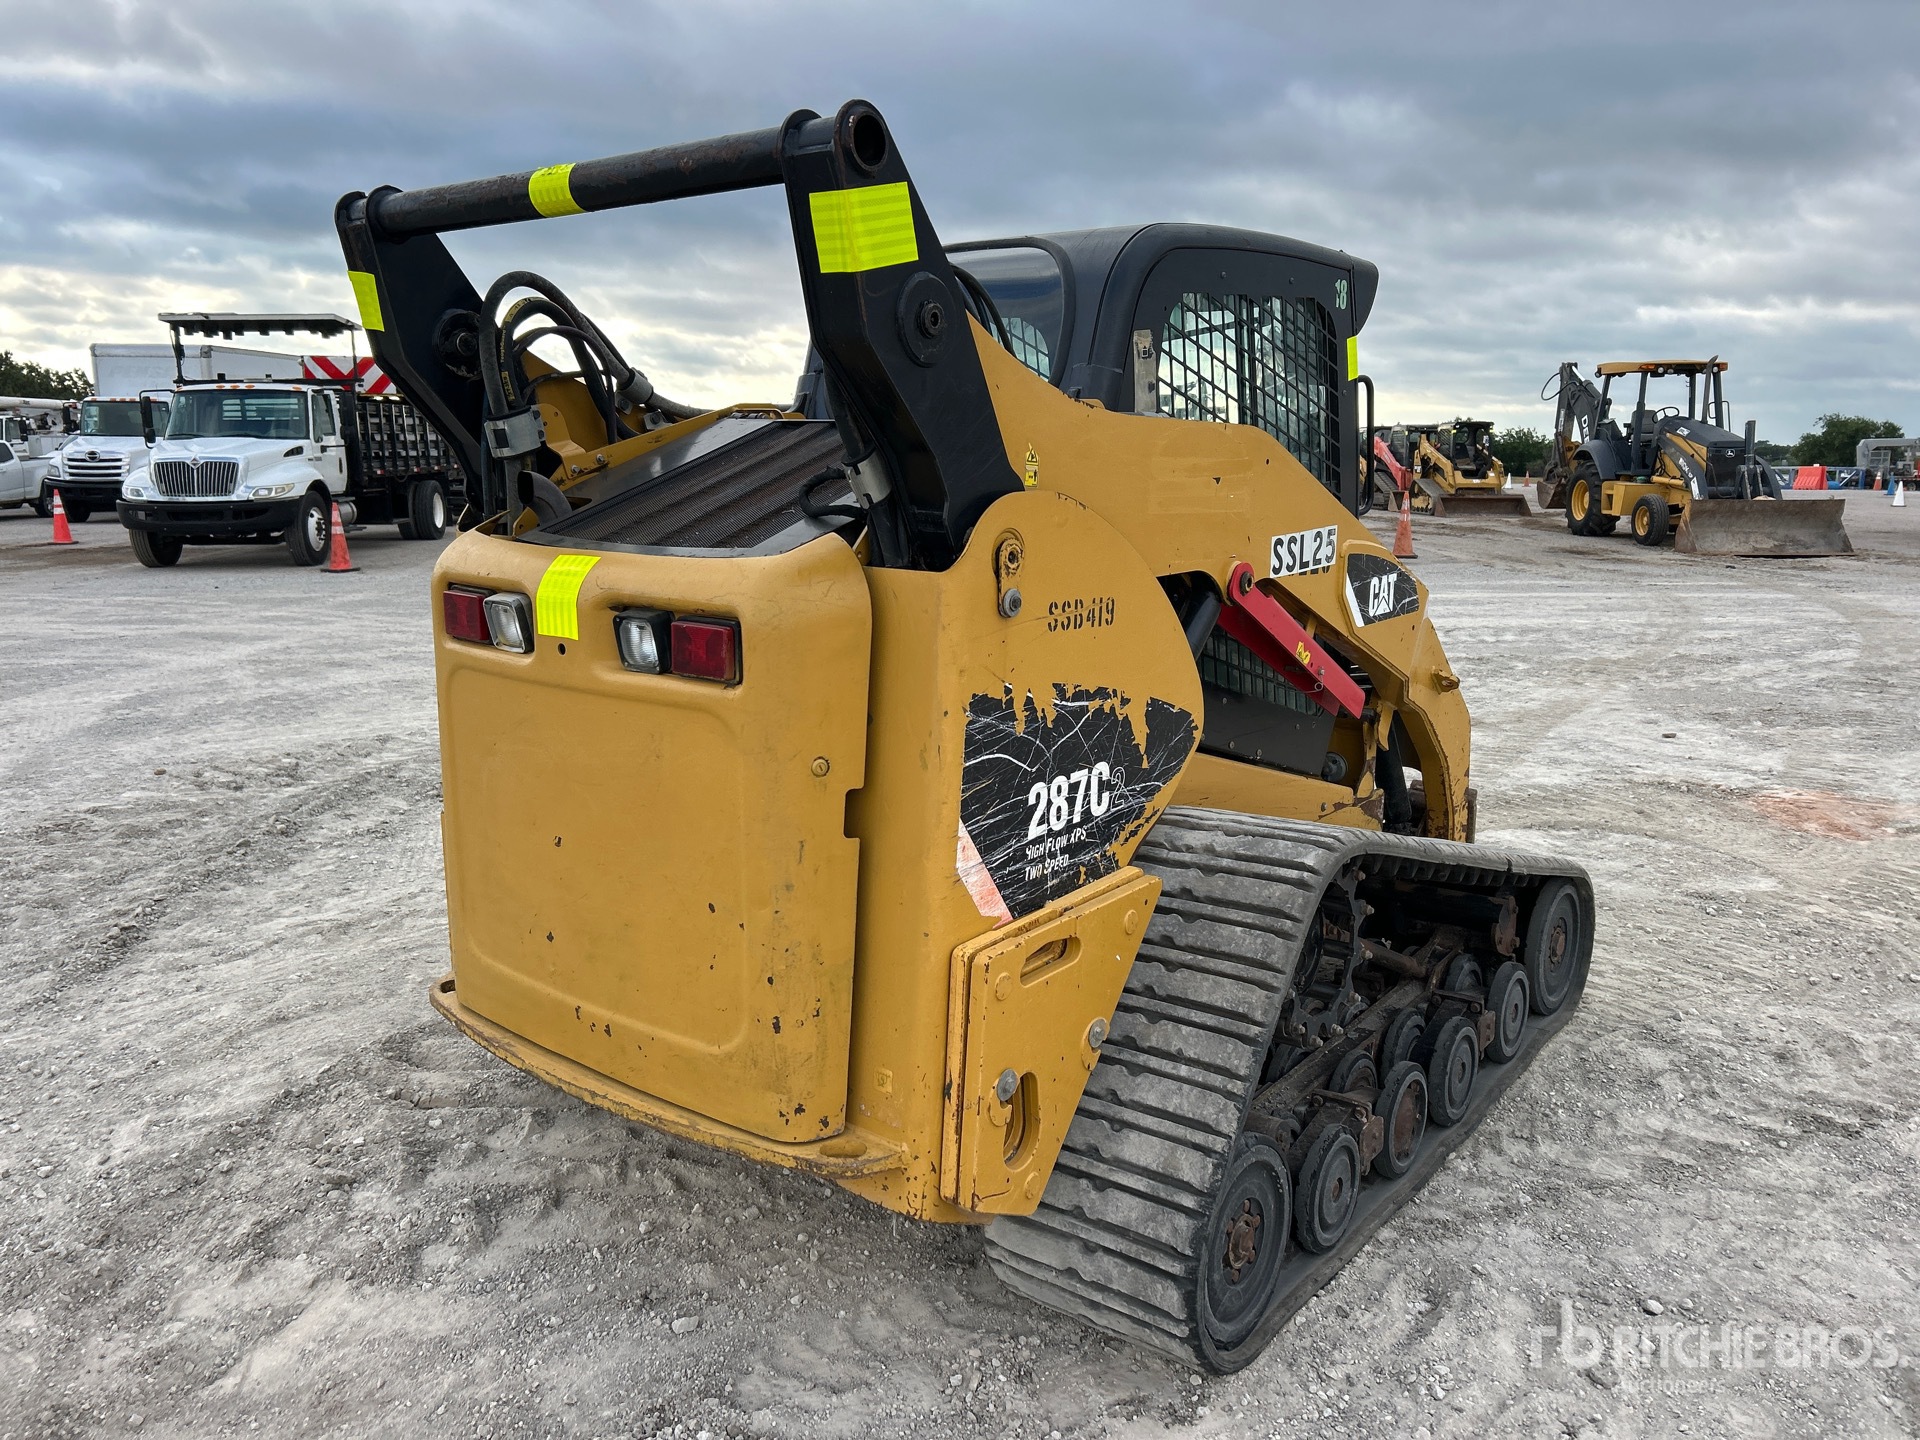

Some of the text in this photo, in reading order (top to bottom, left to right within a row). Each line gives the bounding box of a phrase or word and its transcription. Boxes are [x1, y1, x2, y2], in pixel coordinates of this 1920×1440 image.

[1271, 528, 1336, 576] SSL25
[1369, 573, 1398, 617] CAT
[1046, 834, 1069, 854] FLOW
[1070, 827, 1087, 844] XPS
[1024, 854, 1069, 881] TWO SPEED
